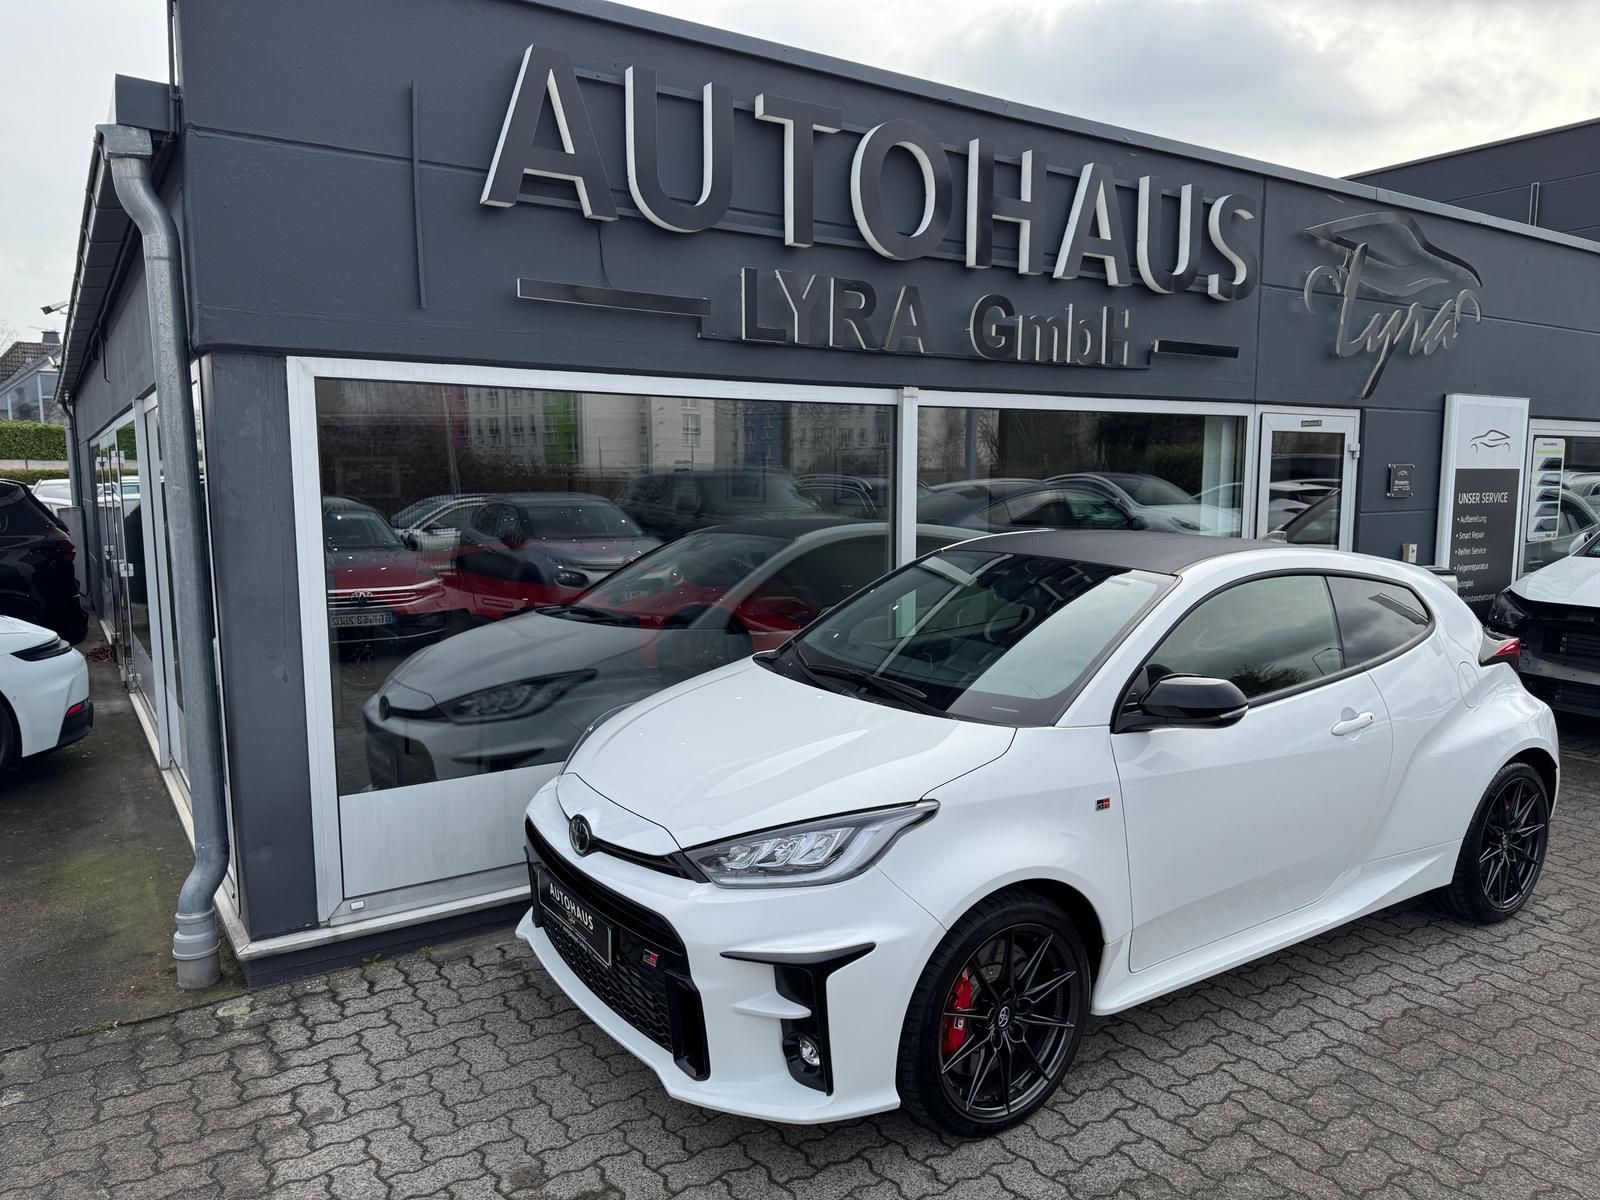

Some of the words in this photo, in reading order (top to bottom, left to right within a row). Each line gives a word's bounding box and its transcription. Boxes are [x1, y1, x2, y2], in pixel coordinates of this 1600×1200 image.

[480, 43, 1259, 302] AUTOHAUS
[740, 266, 930, 355] LYRA
[969, 293, 1134, 368] GmbH
[1458, 492, 1480, 504] UNSER
[1481, 491, 1509, 503] SERVICE
[1459, 531, 1471, 540] Smart
[1472, 531, 1485, 540] Repair
[1471, 546, 1487, 555] Service
[1457, 579, 1474, 588] utoglas
[549, 882, 594, 931] AUTOHAUS
